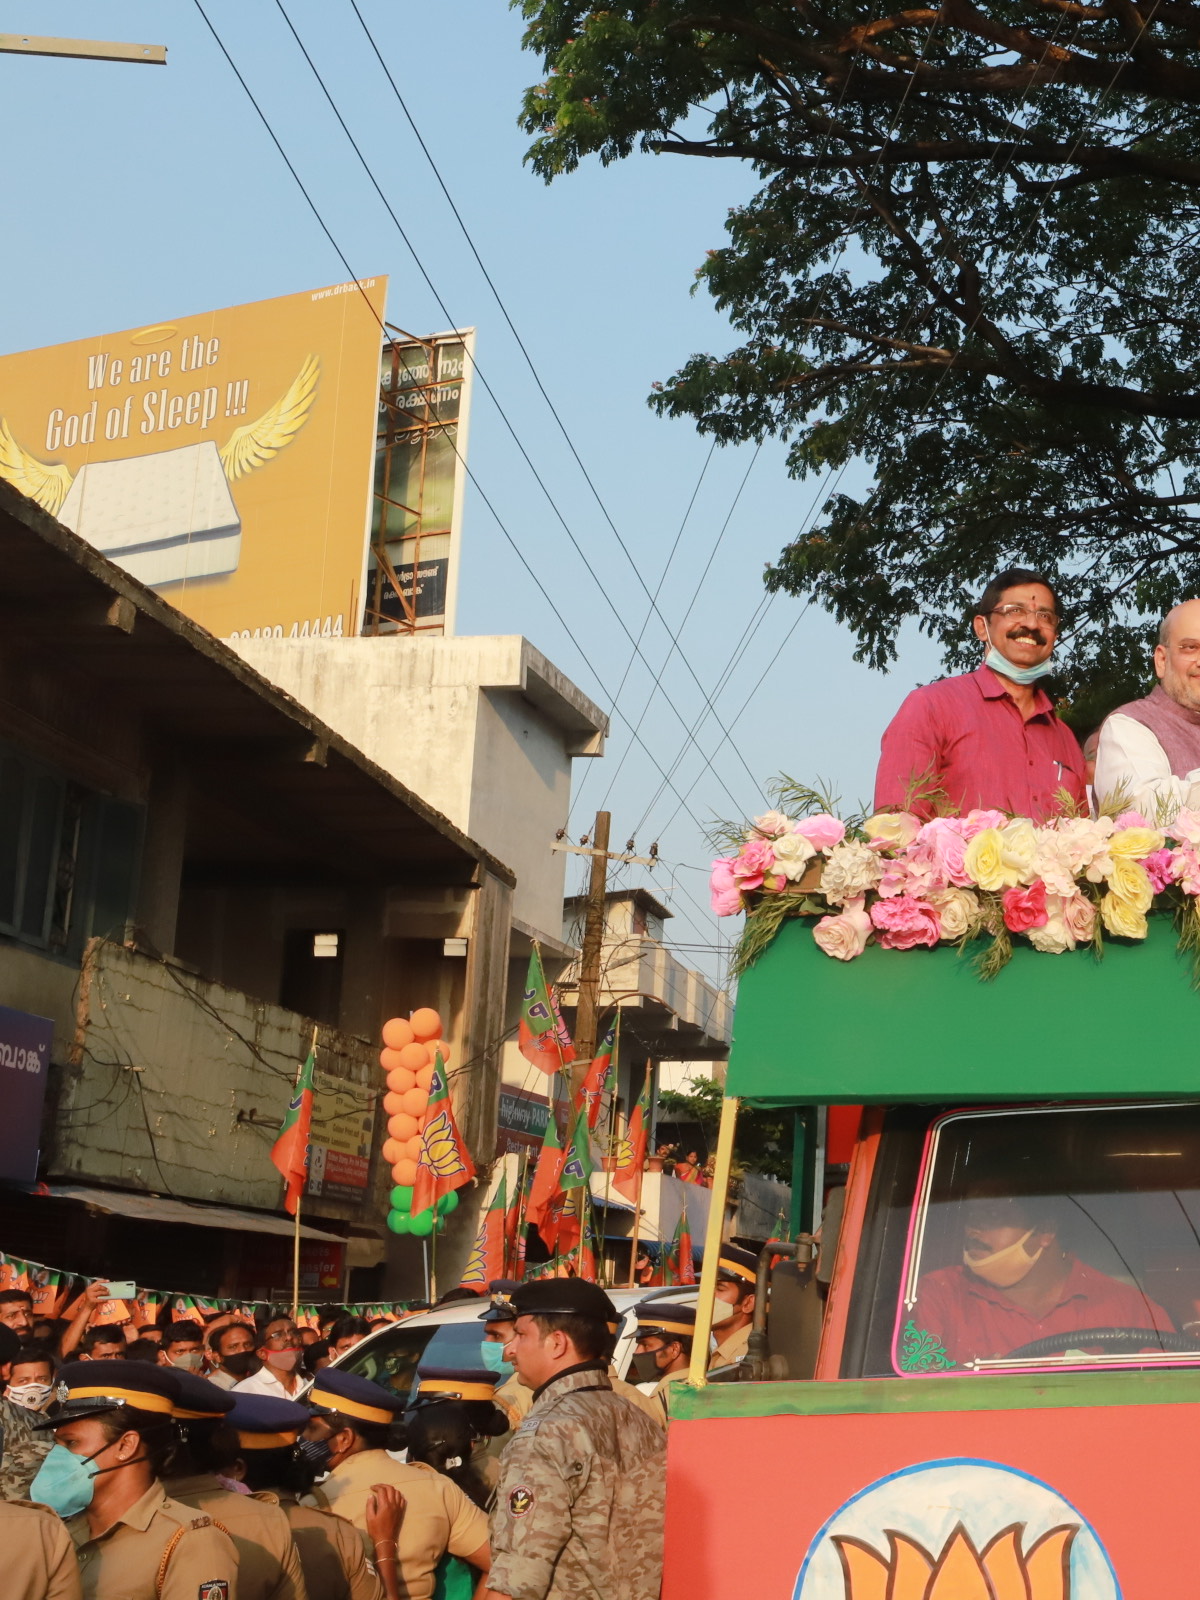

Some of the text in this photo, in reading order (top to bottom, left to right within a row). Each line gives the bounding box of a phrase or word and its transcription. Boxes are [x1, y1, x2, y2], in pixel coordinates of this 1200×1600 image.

[311, 278, 376, 301] www.drback.in
[88, 334, 219, 390] We are the
[46, 379, 249, 451] God of Sleep !!!
